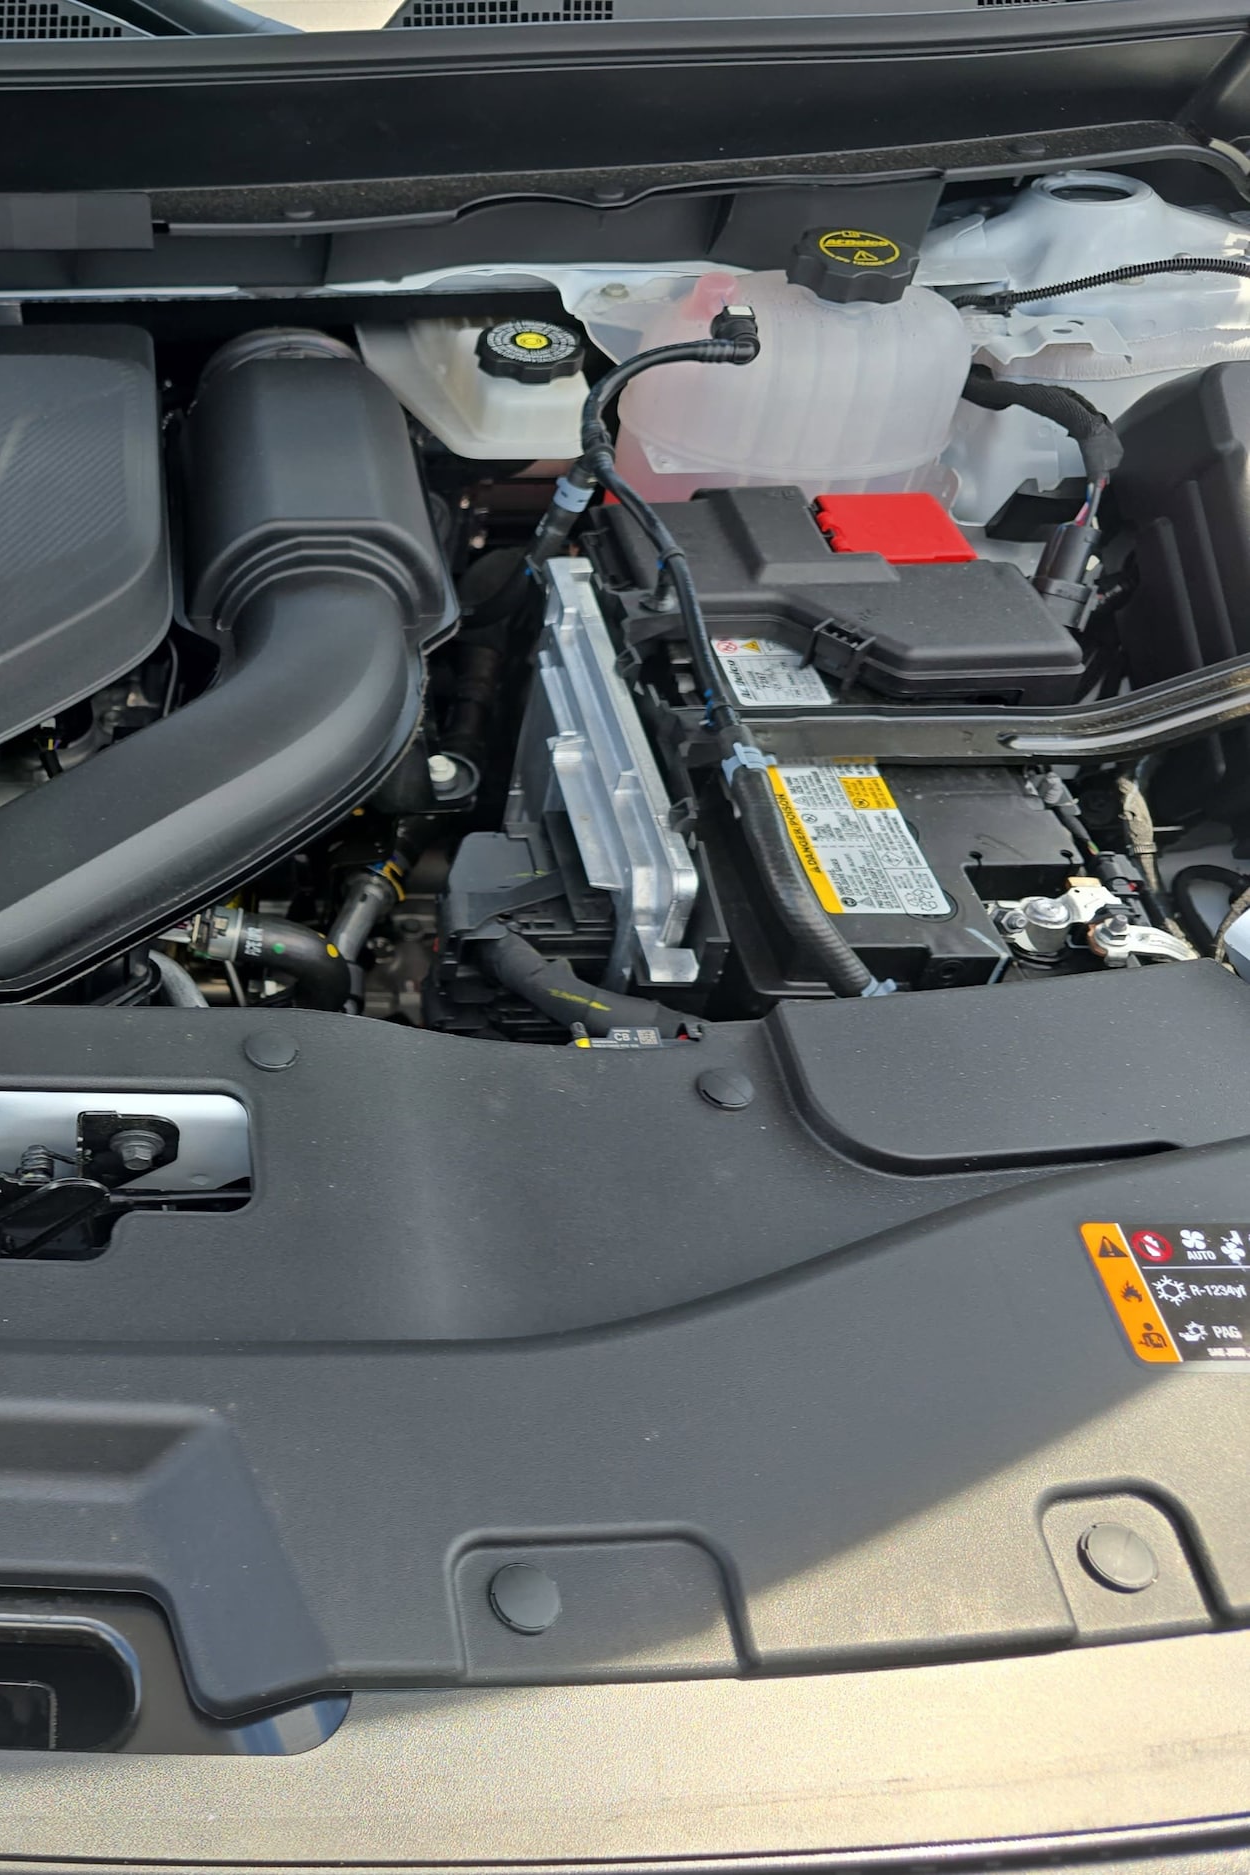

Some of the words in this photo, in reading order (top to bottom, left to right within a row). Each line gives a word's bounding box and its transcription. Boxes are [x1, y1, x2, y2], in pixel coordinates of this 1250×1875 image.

[1186, 1250, 1217, 1261] AUTO
[1188, 1284, 1247, 1299] R-1234yf
[1211, 1325, 1243, 1339] PAG
